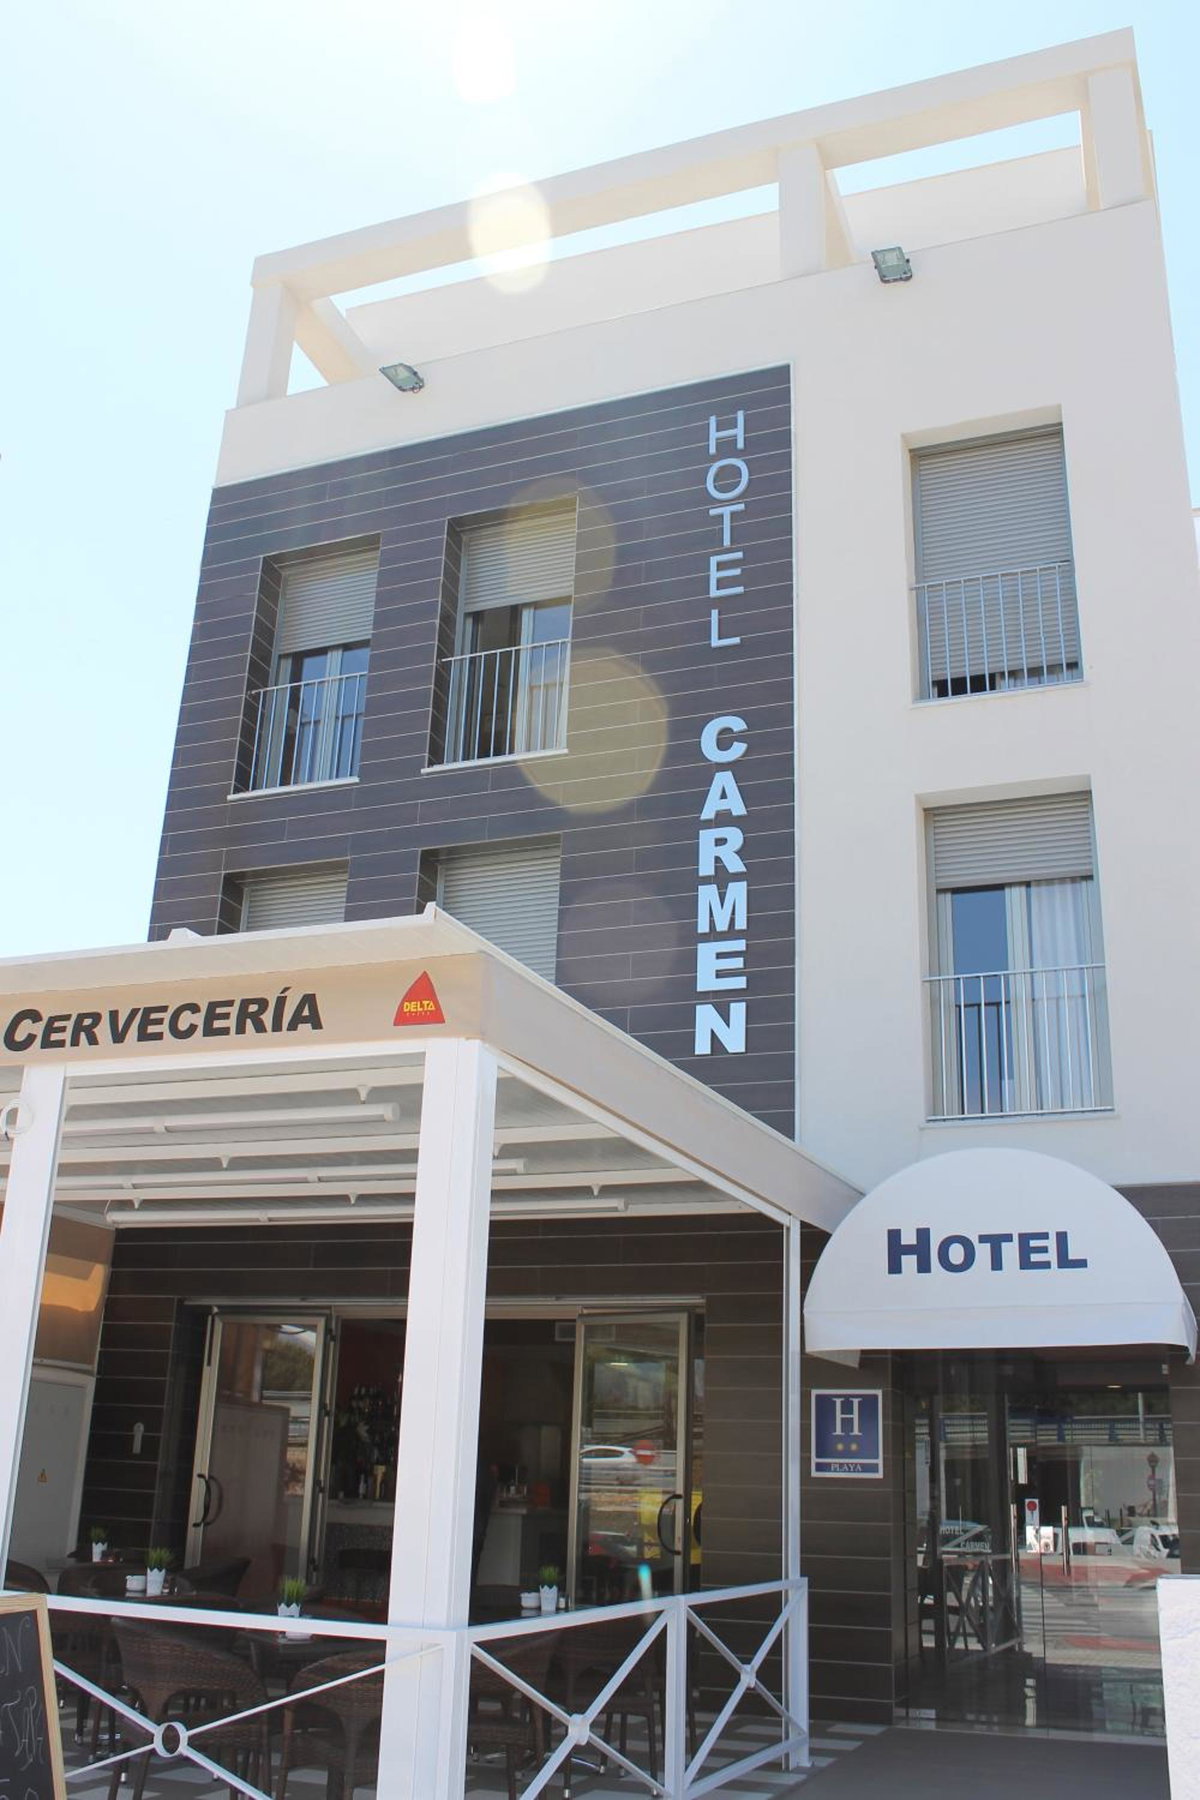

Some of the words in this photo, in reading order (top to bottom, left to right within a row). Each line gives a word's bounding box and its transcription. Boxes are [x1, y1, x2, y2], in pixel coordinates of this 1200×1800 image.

[706, 409, 750, 648] HOTEL
[694, 715, 749, 1056] CARMEN
[3, 986, 325, 1052] CERVECERÍA
[403, 1000, 437, 1013] DELTA
[831, 1397, 863, 1436] H
[830, 1463, 863, 1472] PLAYA
